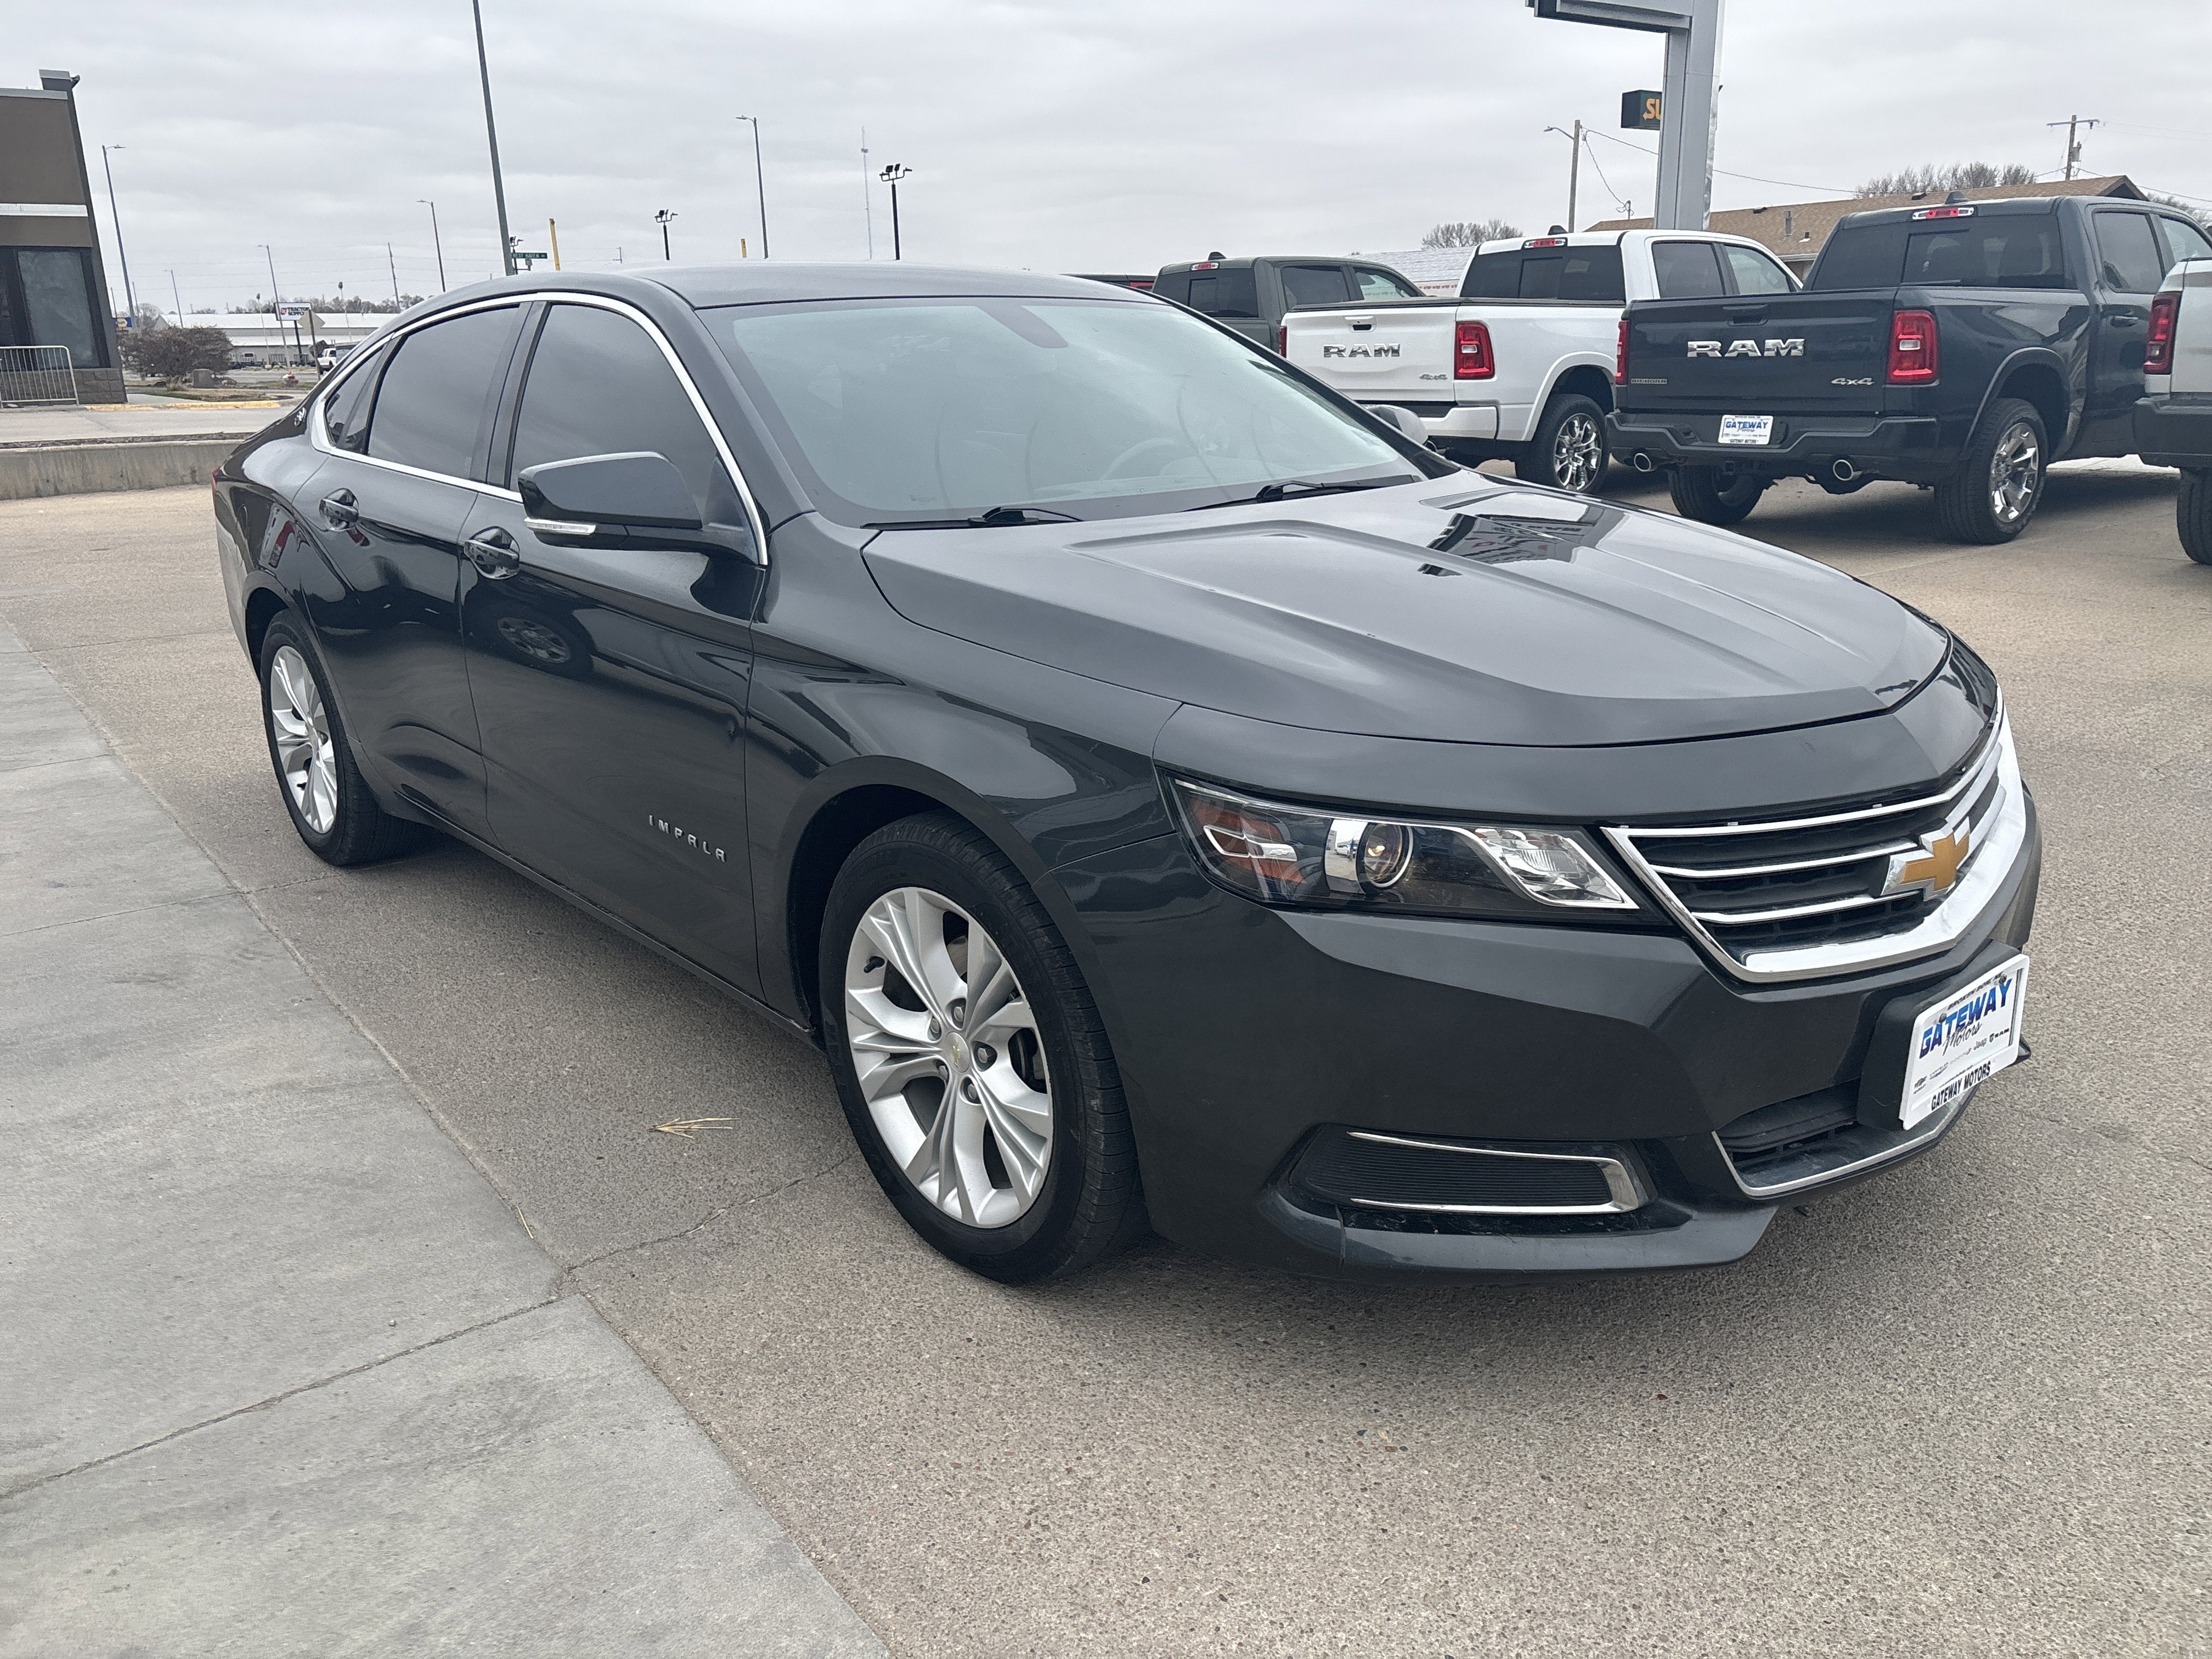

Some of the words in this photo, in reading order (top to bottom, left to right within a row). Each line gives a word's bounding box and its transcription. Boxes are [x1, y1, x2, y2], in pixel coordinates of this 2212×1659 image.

[1323, 343, 1401, 358] RAM
[1687, 338, 1805, 357] RAM
[1725, 421, 1768, 429] GATEWAY
[649, 815, 727, 863] IMPALA
[1919, 978, 2012, 1059] GATEWAY
[1943, 1021, 1982, 1057] Motors
[1932, 1077, 1962, 1111] GATEWAY
[1963, 1060, 1991, 1091] MOTORS
